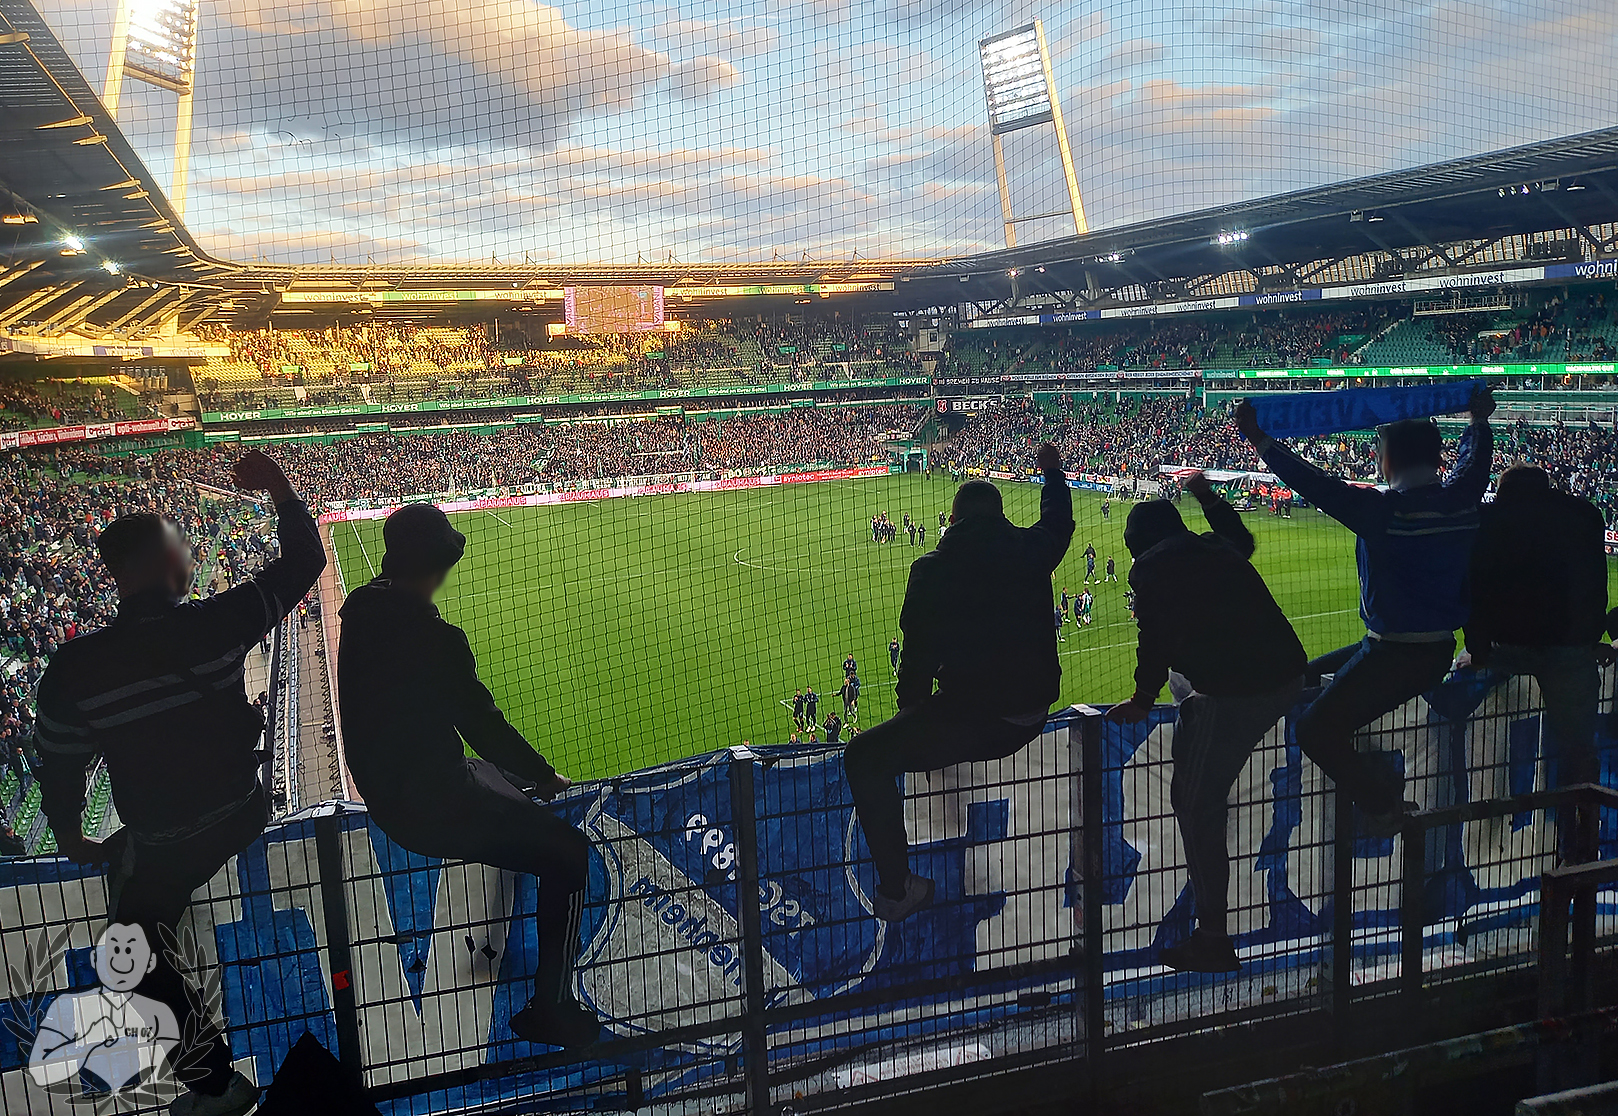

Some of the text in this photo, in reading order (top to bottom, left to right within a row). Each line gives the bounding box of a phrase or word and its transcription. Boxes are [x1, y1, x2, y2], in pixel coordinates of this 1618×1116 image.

[1440, 272, 1505, 288] wohninvest
[759, 286, 806, 295] wohninvest
[834, 283, 881, 293] wohninvest
[1350, 282, 1407, 297] wohninvest
[304, 292, 363, 302] wohninvest
[401, 291, 458, 301] wohninvest
[494, 290, 547, 299] wohninvest
[1256, 291, 1303, 305] wohninvest
[1176, 299, 1216, 312] wohninvest
[1119, 306, 1158, 317] wohninvest
[987, 316, 1027, 327] wohninvest
[1052, 312, 1088, 322] wohninvest
[900, 377, 928, 385] HOYER
[660, 390, 691, 398] HOYER
[526, 396, 560, 404] HOYER
[382, 403, 419, 412] HOYER
[220, 411, 261, 421] HOYER
[117, 420, 168, 435] opti-wohnwelt.de
[721, 477, 760, 488] BAUHAUS
[564, 490, 609, 501] BAUHAUS
[480, 496, 527, 508] BAUHAUS
